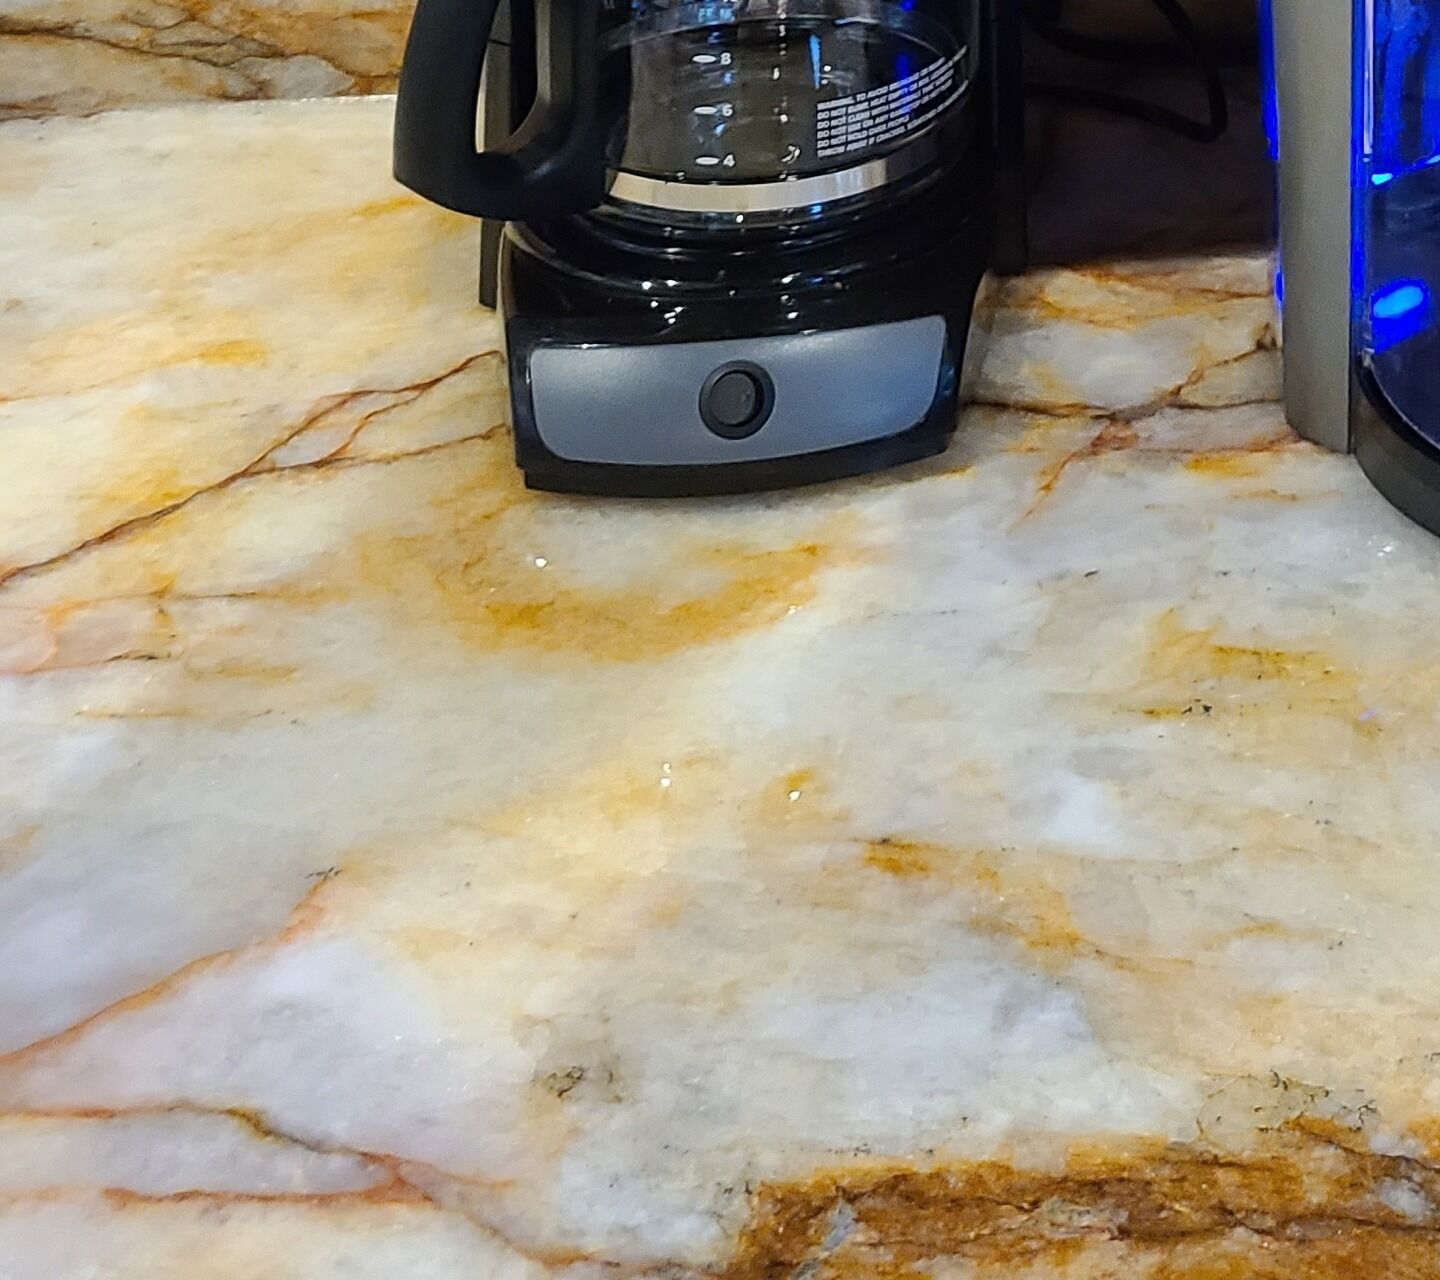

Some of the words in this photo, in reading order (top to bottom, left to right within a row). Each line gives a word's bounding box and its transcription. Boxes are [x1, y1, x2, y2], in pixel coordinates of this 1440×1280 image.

[720, 52, 732, 65] 8
[721, 104, 734, 117] 6
[722, 154, 735, 168] 4
